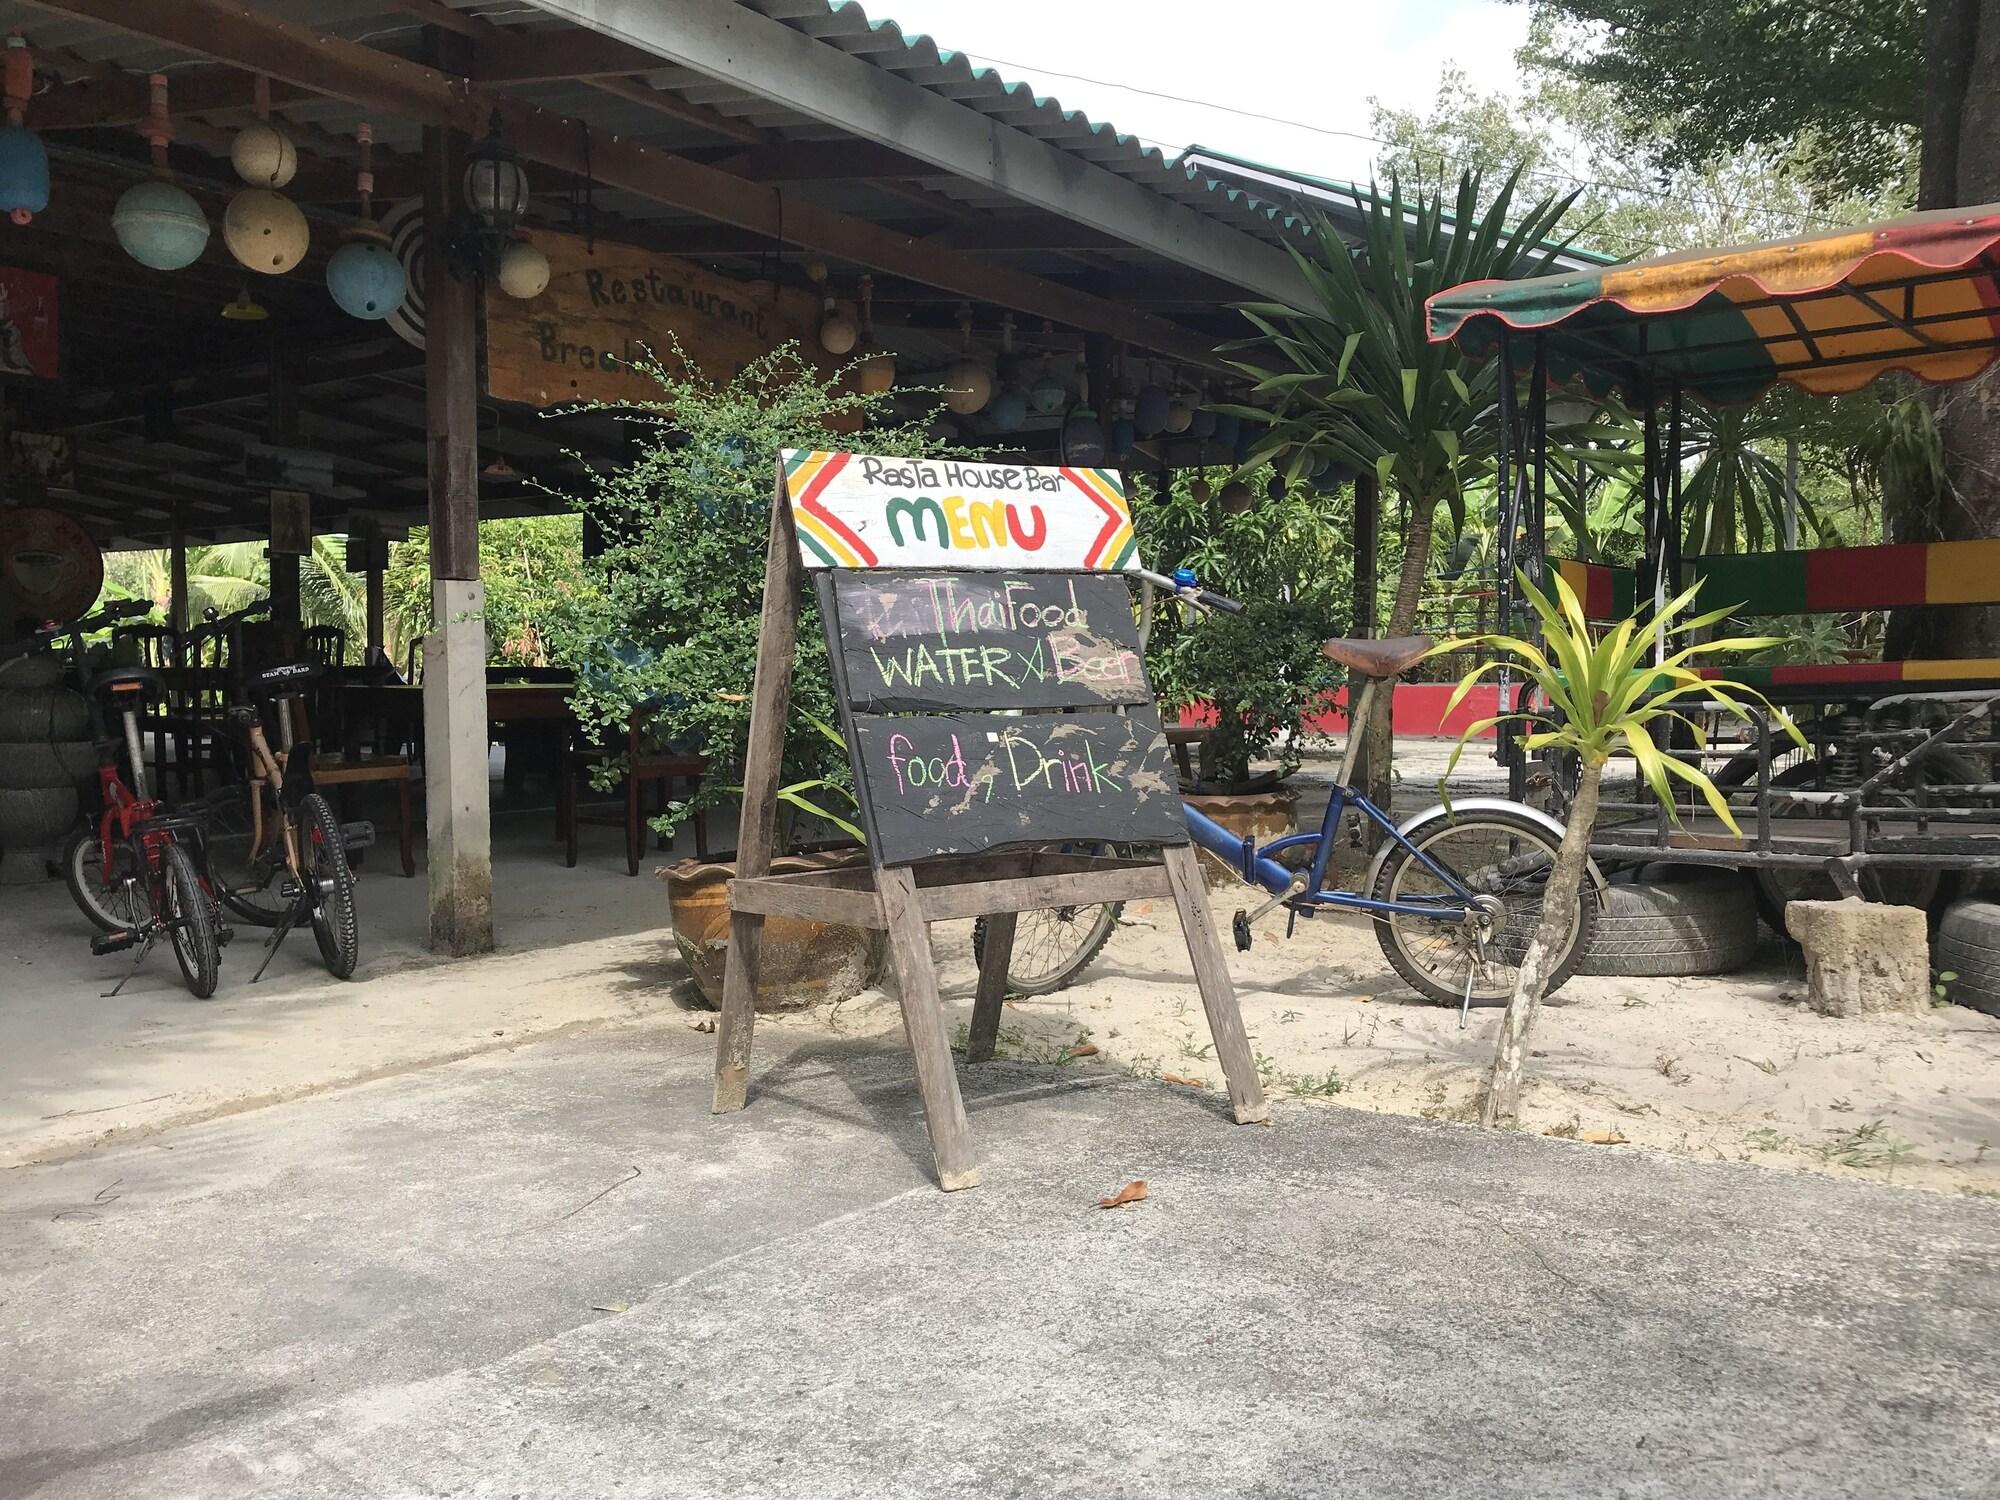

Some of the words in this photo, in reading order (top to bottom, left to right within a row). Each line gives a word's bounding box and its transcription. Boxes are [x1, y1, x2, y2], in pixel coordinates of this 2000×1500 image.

[586, 268, 768, 338] Restaurant
[944, 463, 1023, 490] House
[1023, 466, 1065, 493] Bar
[885, 496, 1046, 551] MENU
[869, 642, 1021, 690] WATER
[1004, 730, 1123, 793] Drink
